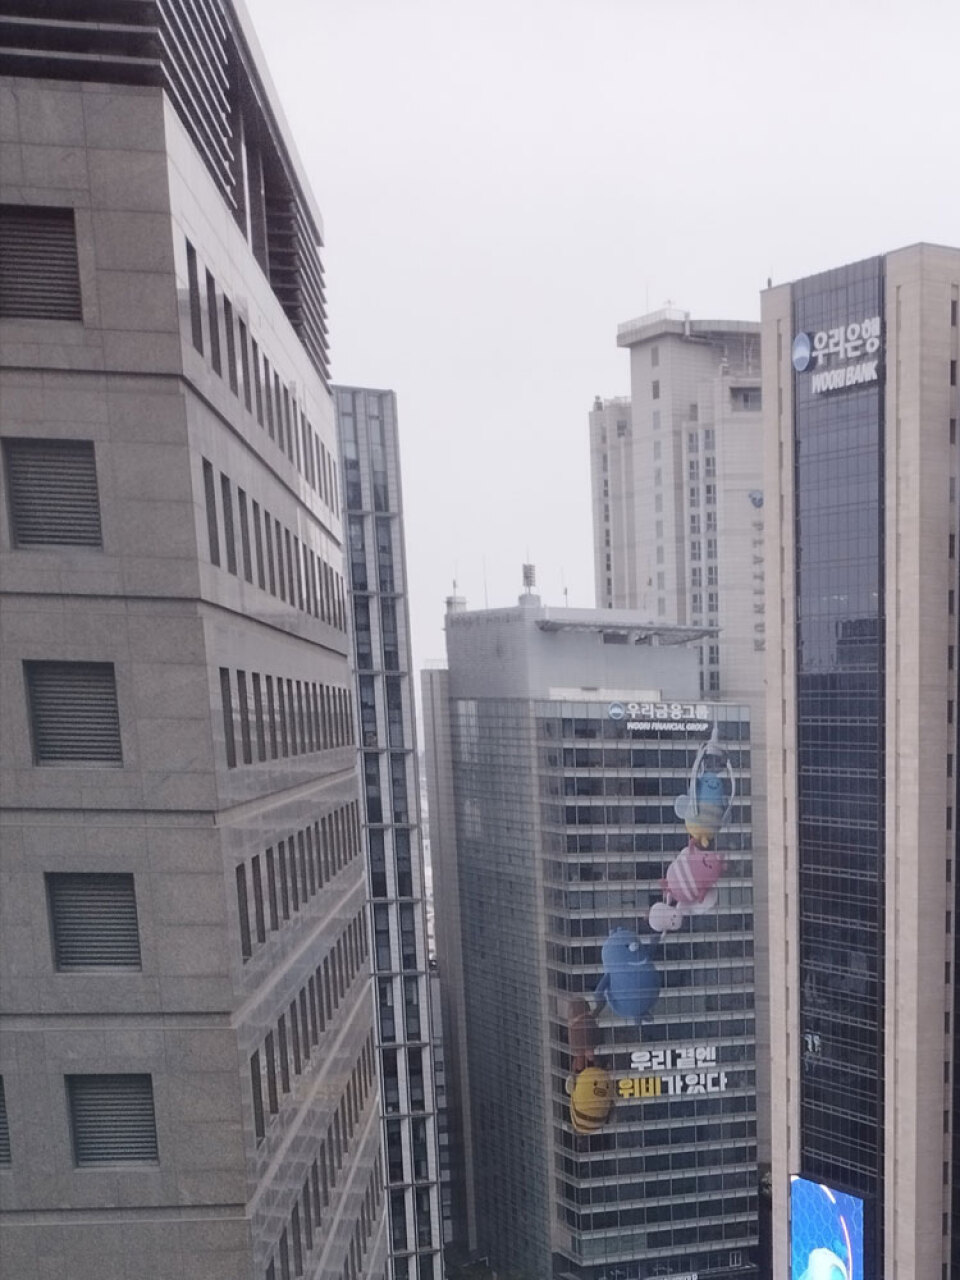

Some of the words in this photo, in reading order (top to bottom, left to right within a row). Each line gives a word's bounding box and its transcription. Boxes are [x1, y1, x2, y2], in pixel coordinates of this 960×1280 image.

[812, 316, 881, 365] 우리은행
[812, 368, 846, 394] WOORI
[846, 360, 878, 386] BANK
[626, 702, 709, 720] 우리금융그룹
[630, 1049, 672, 1071] 우리
[618, 1074, 683, 1098] 위비가
[685, 1072, 728, 1095] 있다
